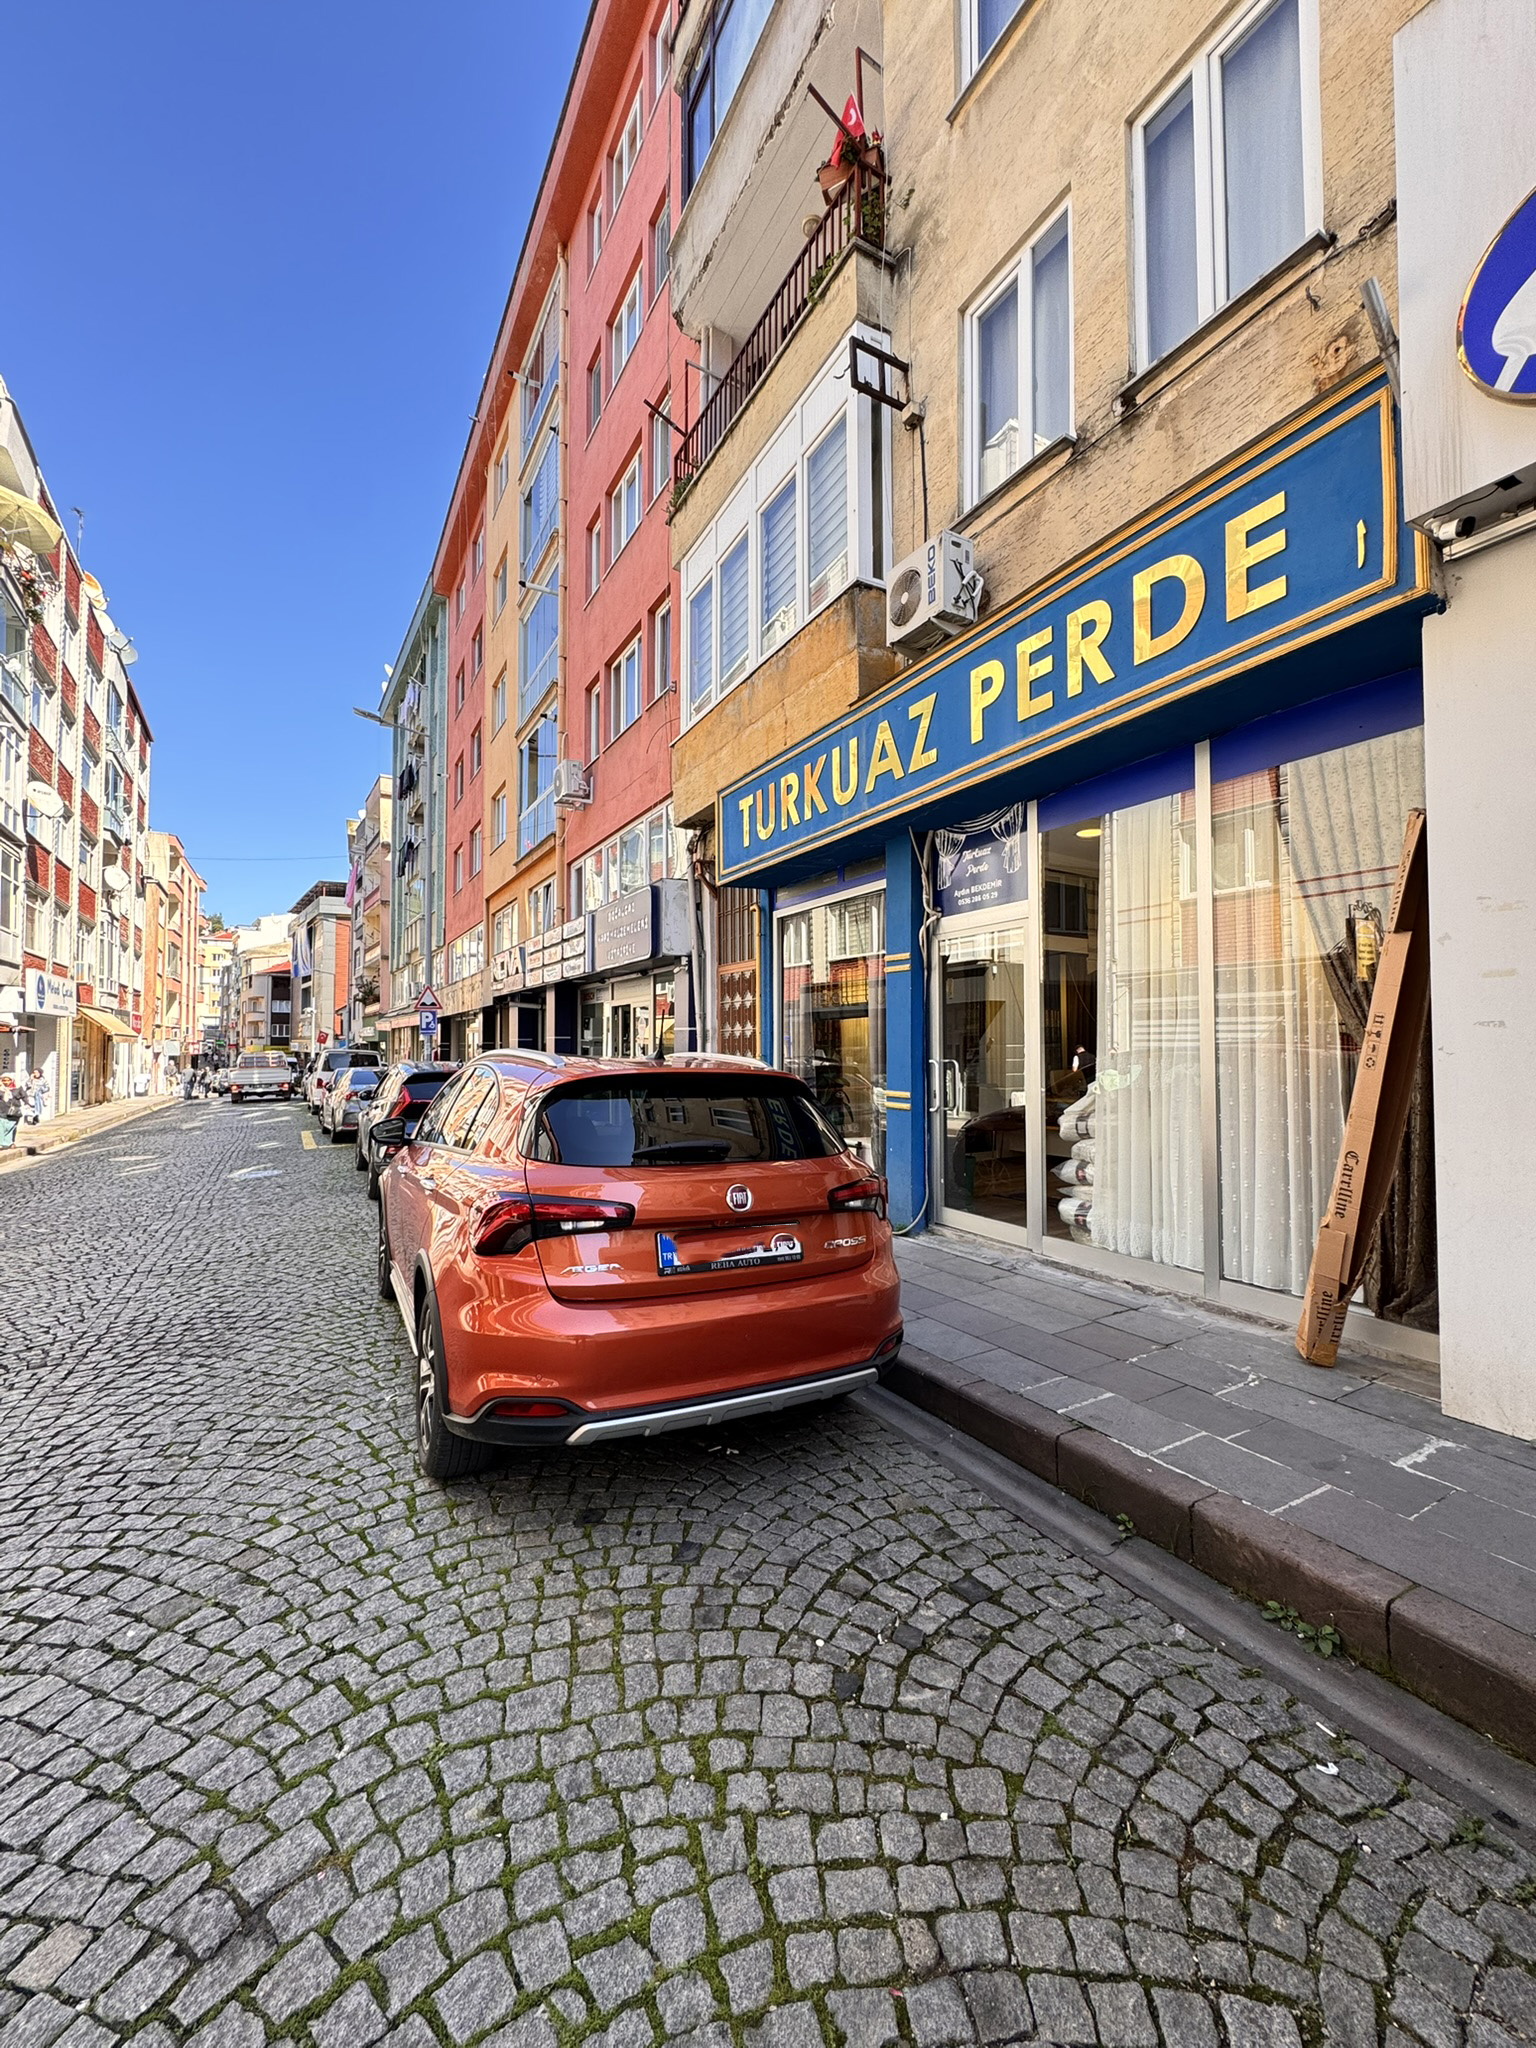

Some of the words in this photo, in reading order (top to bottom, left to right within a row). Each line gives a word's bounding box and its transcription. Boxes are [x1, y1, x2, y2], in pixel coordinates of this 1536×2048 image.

[927, 544, 936, 605] BEKO
[739, 692, 938, 848] TURKUAZ
[970, 490, 1287, 745] PERDE
[1334, 1150, 1359, 1219] Carrlline
[732, 1191, 747, 1205] FIAT
[823, 1234, 867, 1249] CROSS
[662, 1252, 673, 1261] TR
[710, 1261, 735, 1270] REHA
[737, 1258, 761, 1267] AUTO
